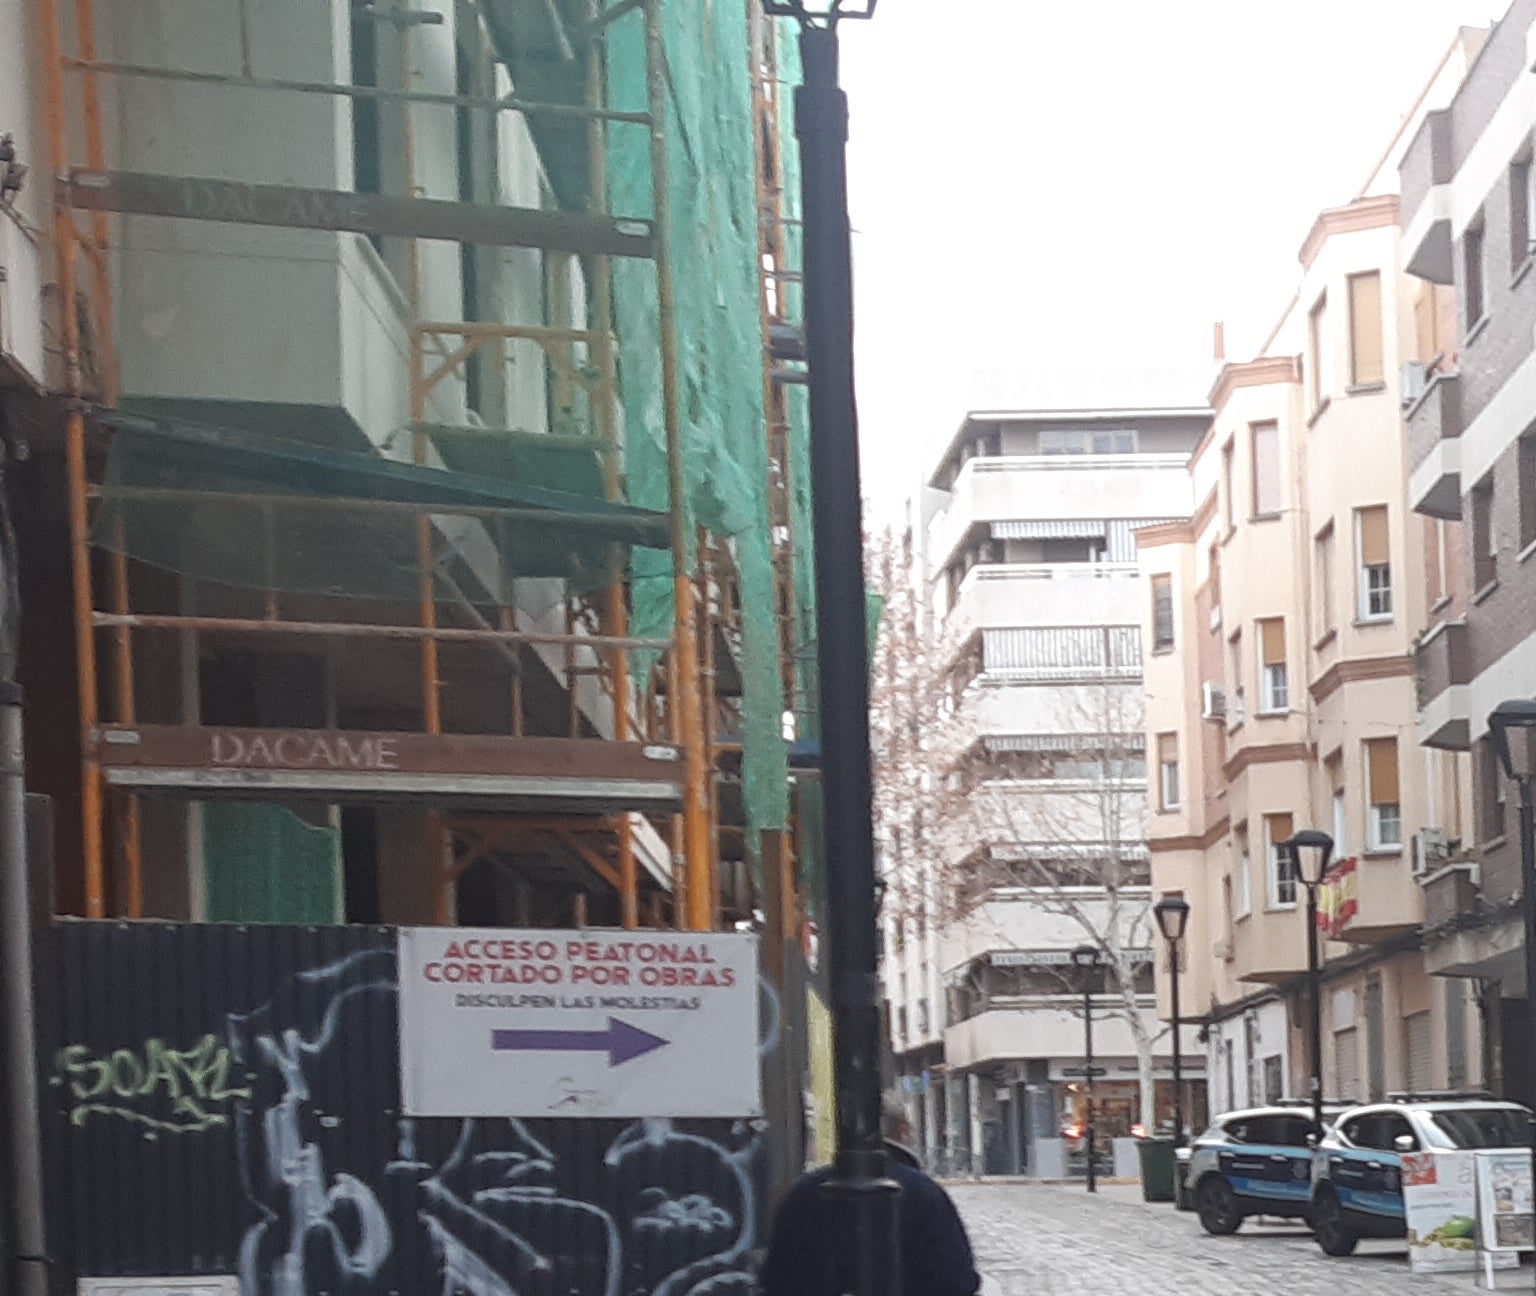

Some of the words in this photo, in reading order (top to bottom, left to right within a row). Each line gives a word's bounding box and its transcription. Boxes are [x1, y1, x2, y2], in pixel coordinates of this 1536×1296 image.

[210, 734, 399, 769] DACAME
[444, 939, 557, 962] ACCESO
[567, 941, 716, 963] PEATONAL
[423, 962, 563, 984] CORTADO
[571, 964, 629, 985] POR
[638, 966, 736, 987] OBRAS
[455, 993, 554, 1008] DISCULPEN
[561, 994, 594, 1009] LAS
[599, 995, 701, 1010] MOLESTIAS
